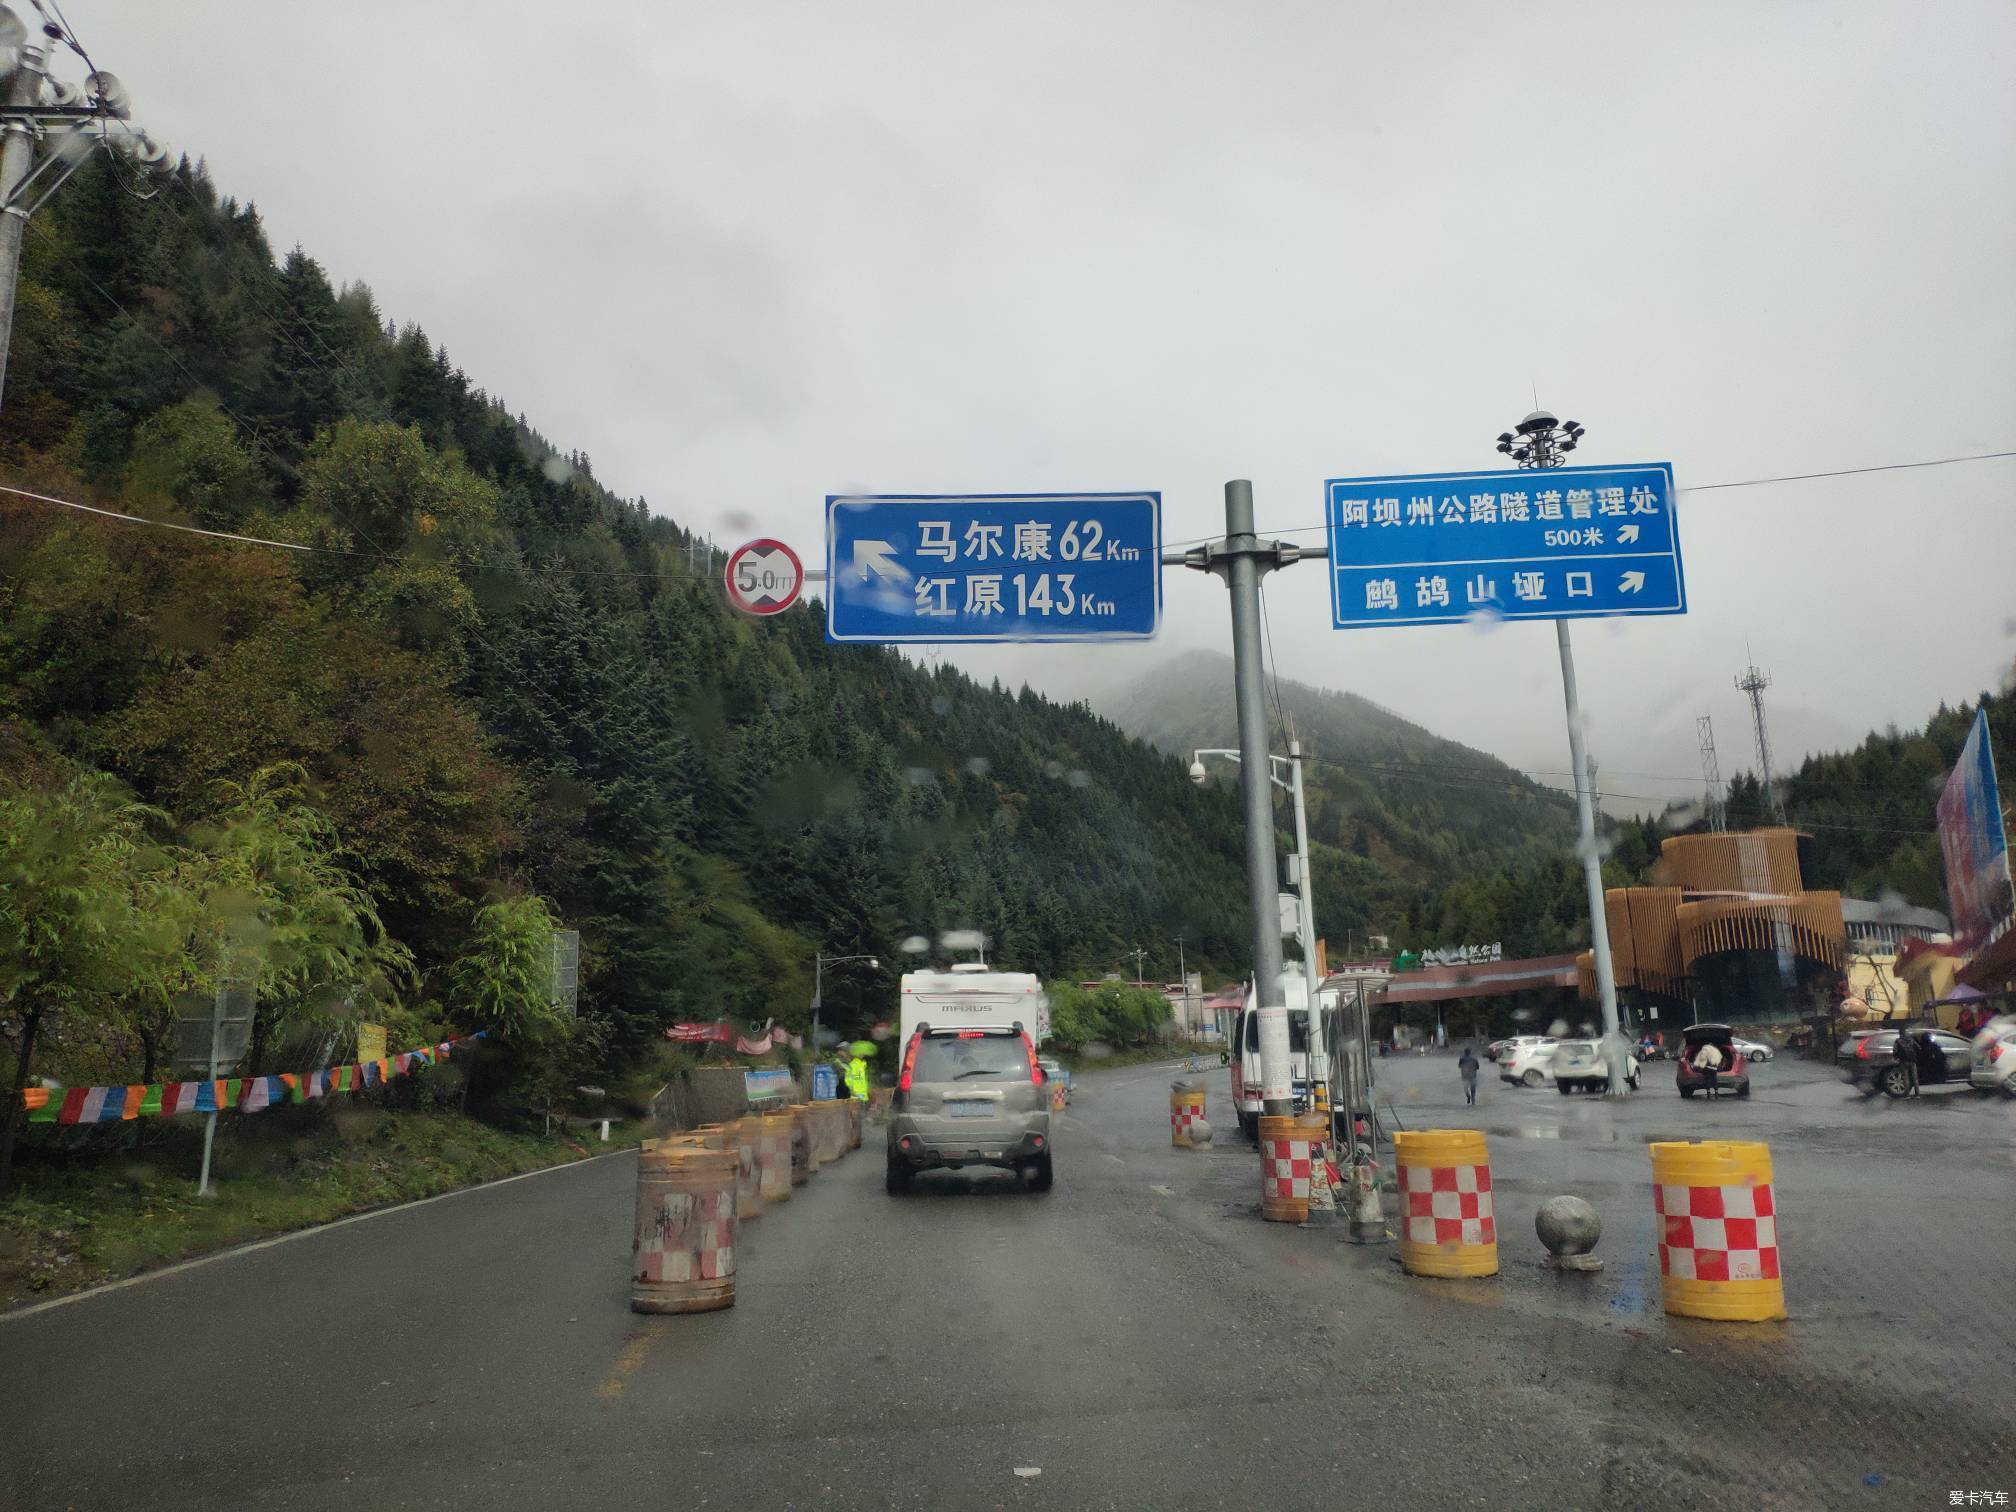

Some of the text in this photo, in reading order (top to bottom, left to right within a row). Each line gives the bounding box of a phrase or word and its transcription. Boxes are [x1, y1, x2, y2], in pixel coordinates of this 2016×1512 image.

[1342, 485, 1659, 528] 阿坝州公路隧道管理处
[1544, 527, 1604, 547] 500米
[738, 562, 792, 592] 5.0m
[1365, 571, 1593, 611] 鹧鸪山垭口
